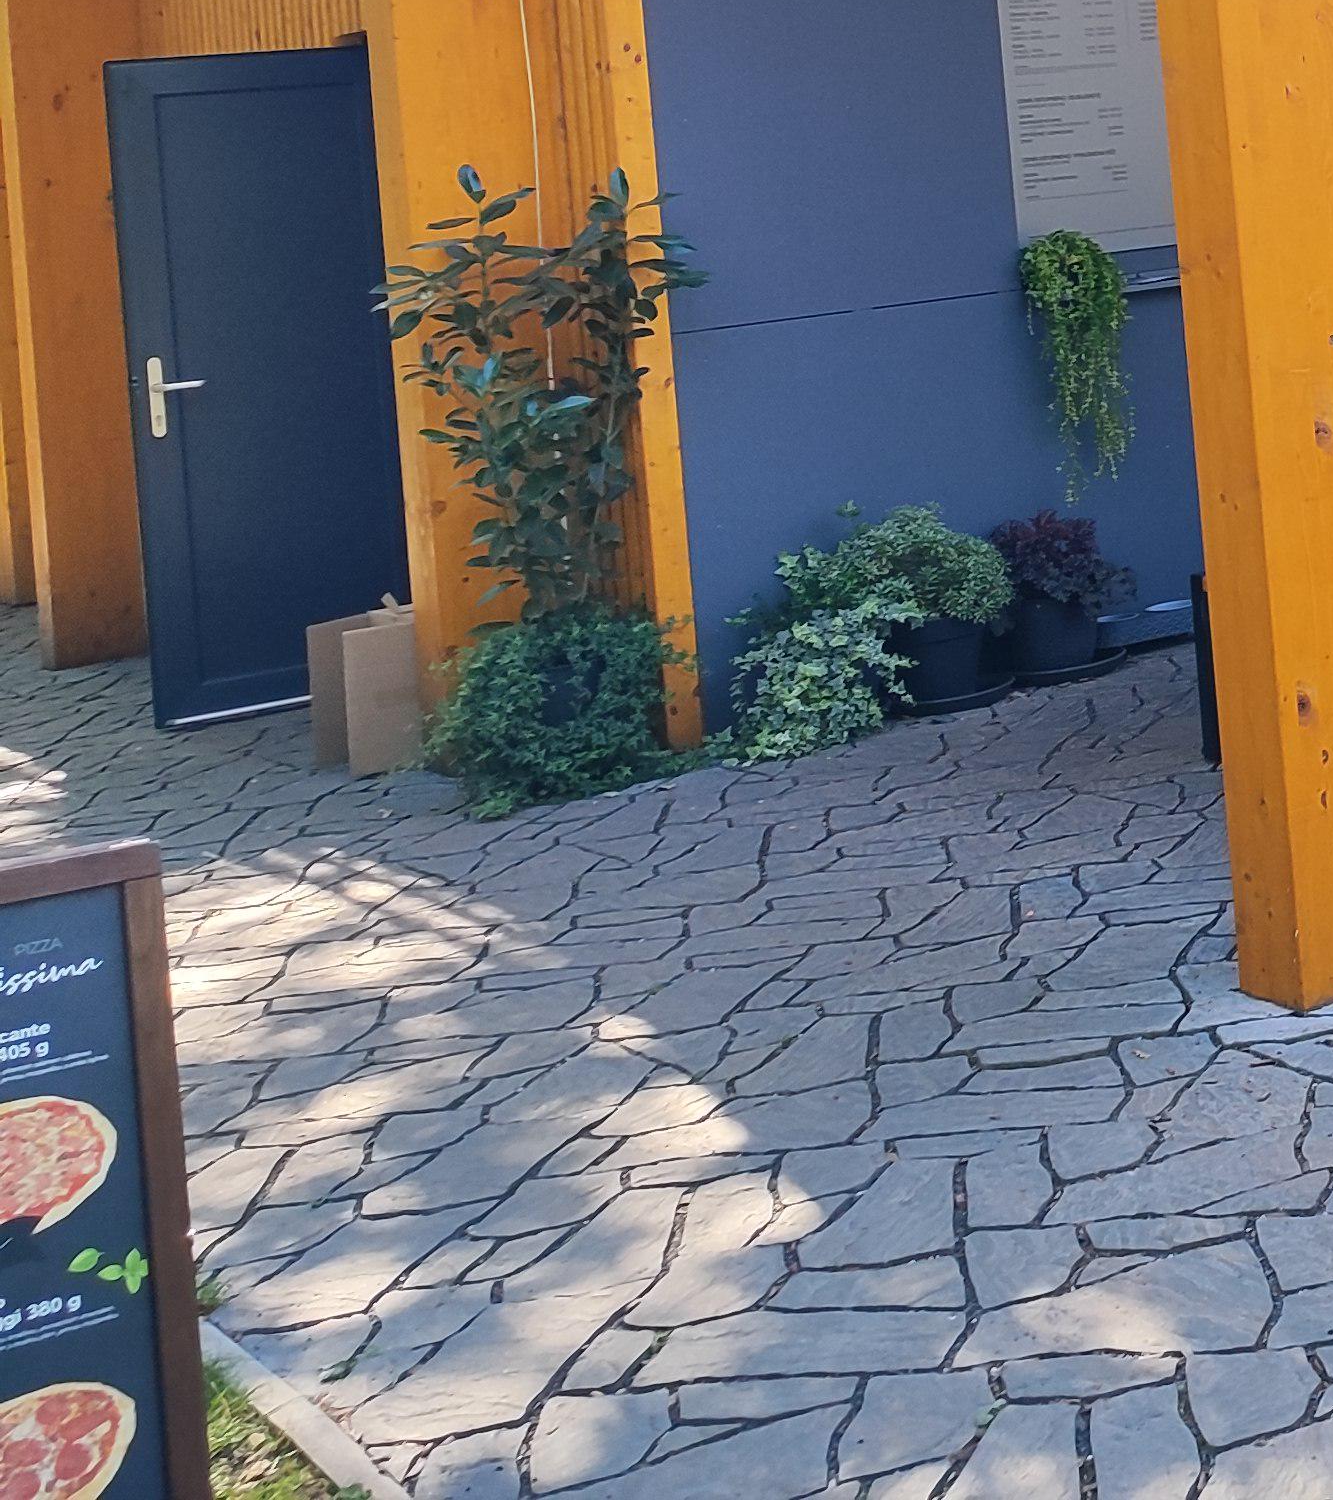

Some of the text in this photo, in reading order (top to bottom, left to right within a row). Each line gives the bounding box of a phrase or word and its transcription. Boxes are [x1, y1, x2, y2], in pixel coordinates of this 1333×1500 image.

[14, 937, 64, 956] PIZZA
[34, 1040, 50, 1058] g
[25, 1296, 63, 1321] 380
[66, 1294, 82, 1314] g
